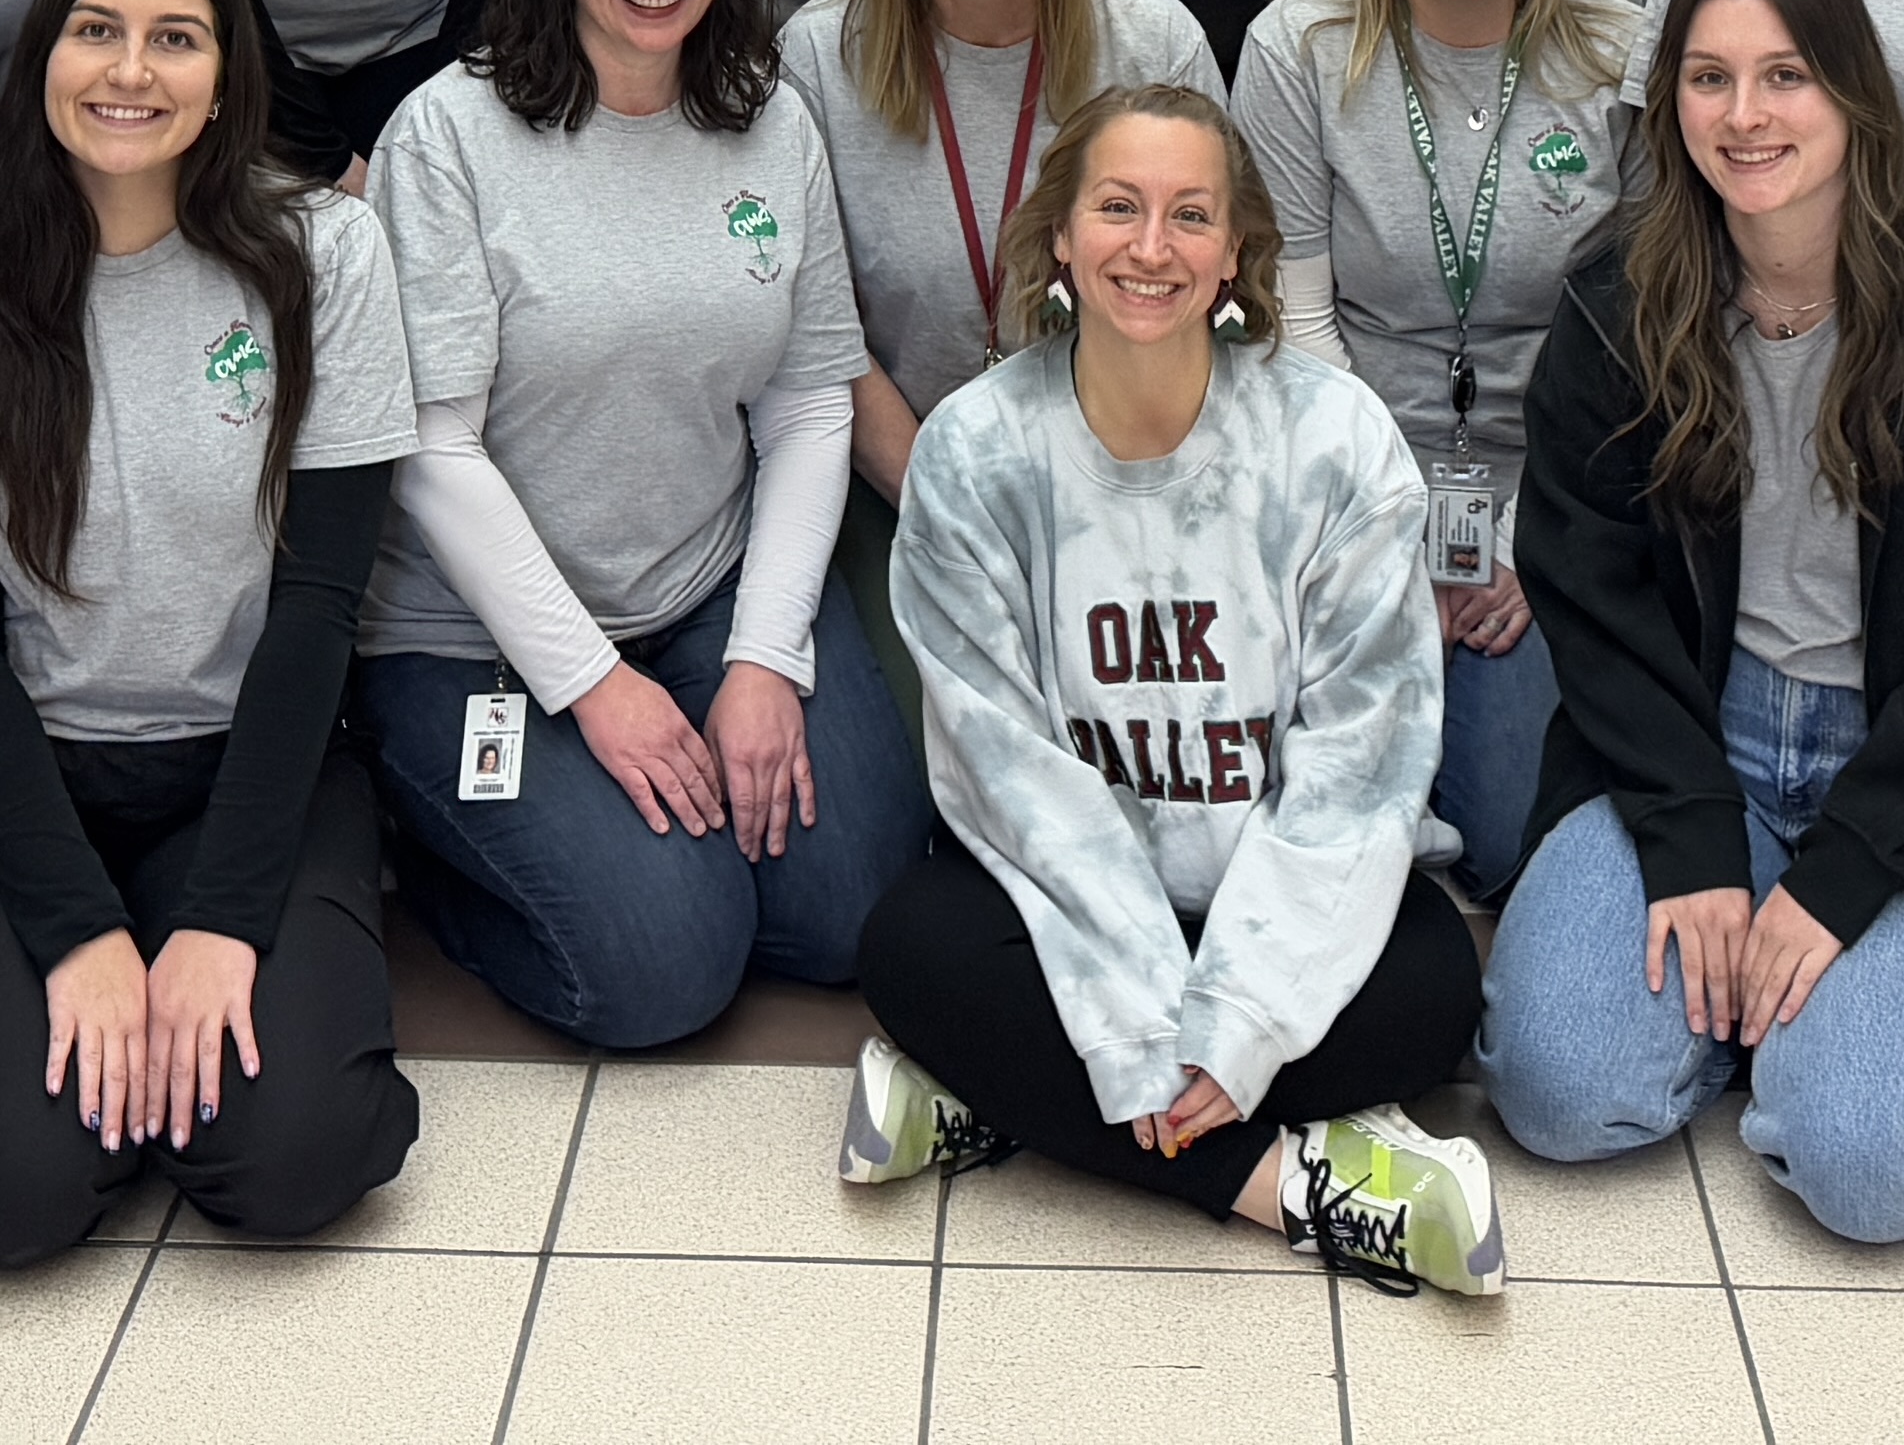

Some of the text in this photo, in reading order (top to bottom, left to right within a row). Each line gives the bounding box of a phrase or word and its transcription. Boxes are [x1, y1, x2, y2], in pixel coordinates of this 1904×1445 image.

[1432, 206, 1460, 280] VALLEY
[1467, 183, 1497, 262] VALLEY
[1086, 599, 1226, 685] OAK
